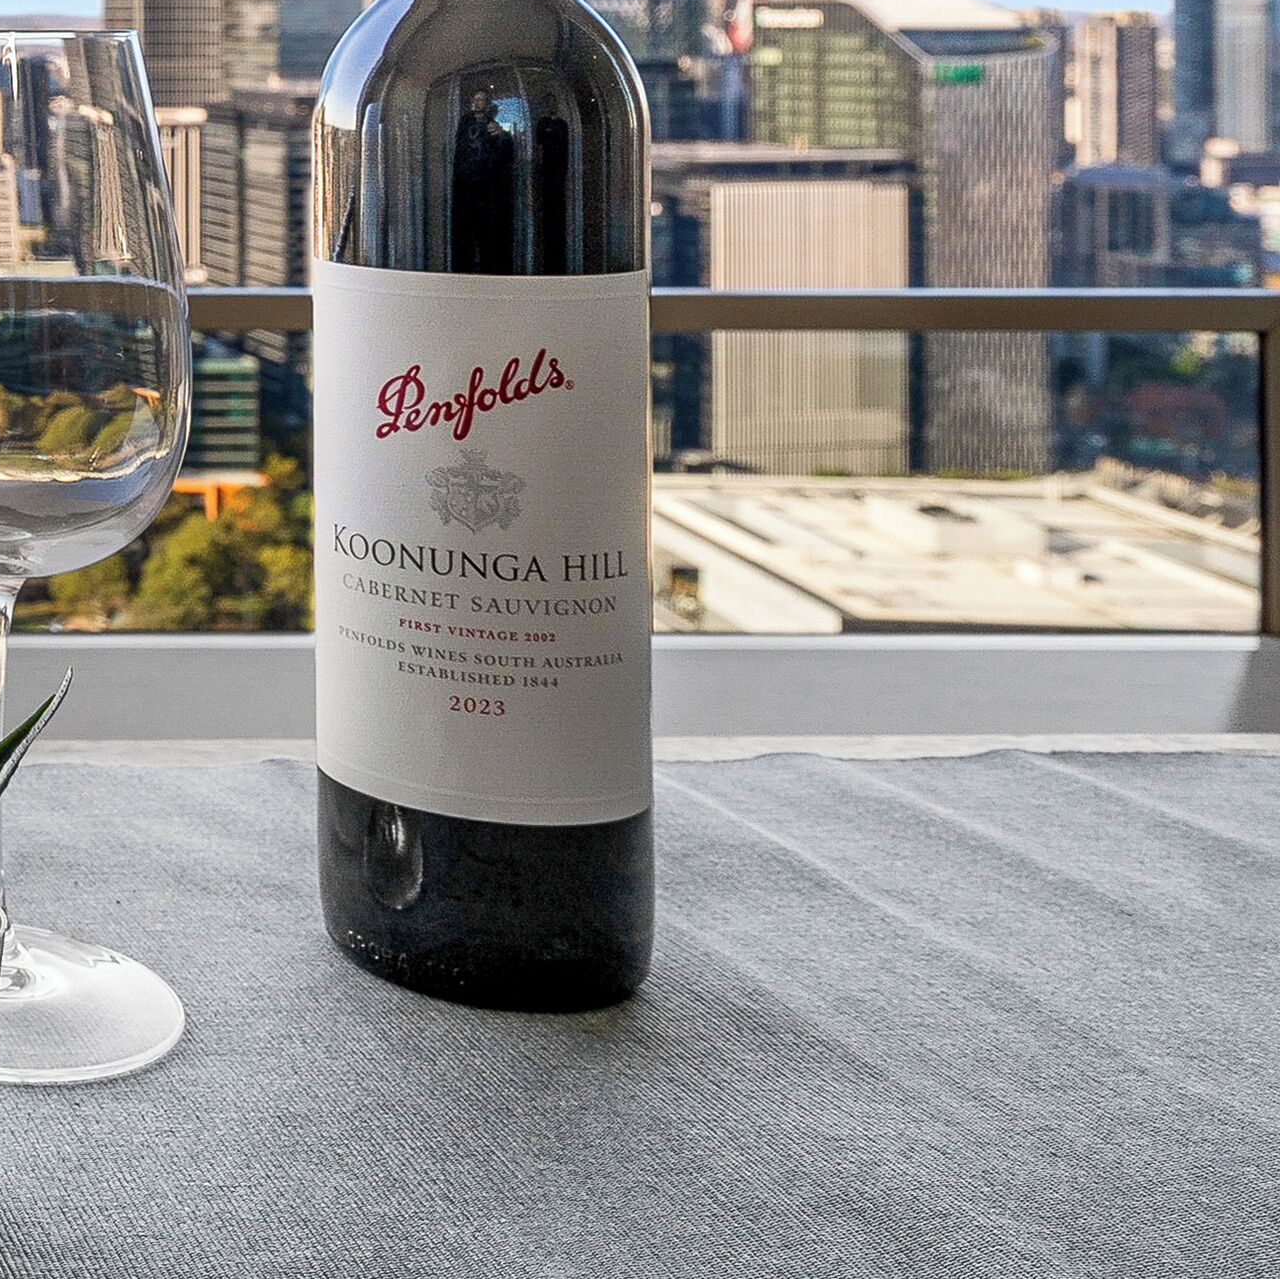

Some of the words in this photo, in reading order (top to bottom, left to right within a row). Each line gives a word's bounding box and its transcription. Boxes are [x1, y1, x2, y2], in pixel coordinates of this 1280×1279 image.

[334, 523, 549, 583] KOONUNGA
[561, 550, 628, 582] HILL
[342, 572, 460, 610] CABERNET
[471, 595, 617, 617] SAUVIGNON
[339, 624, 406, 653] PENFOLDS
[411, 644, 468, 664] WINES
[473, 653, 536, 669] SOUTH
[541, 652, 625, 669] AUSTRALIA
[398, 617, 442, 635] FIRST
[447, 625, 519, 642] VINTAGE
[397, 660, 516, 687] ESTABLISHED
[522, 675, 560, 689] 1844
[448, 694, 506, 718] 2023
